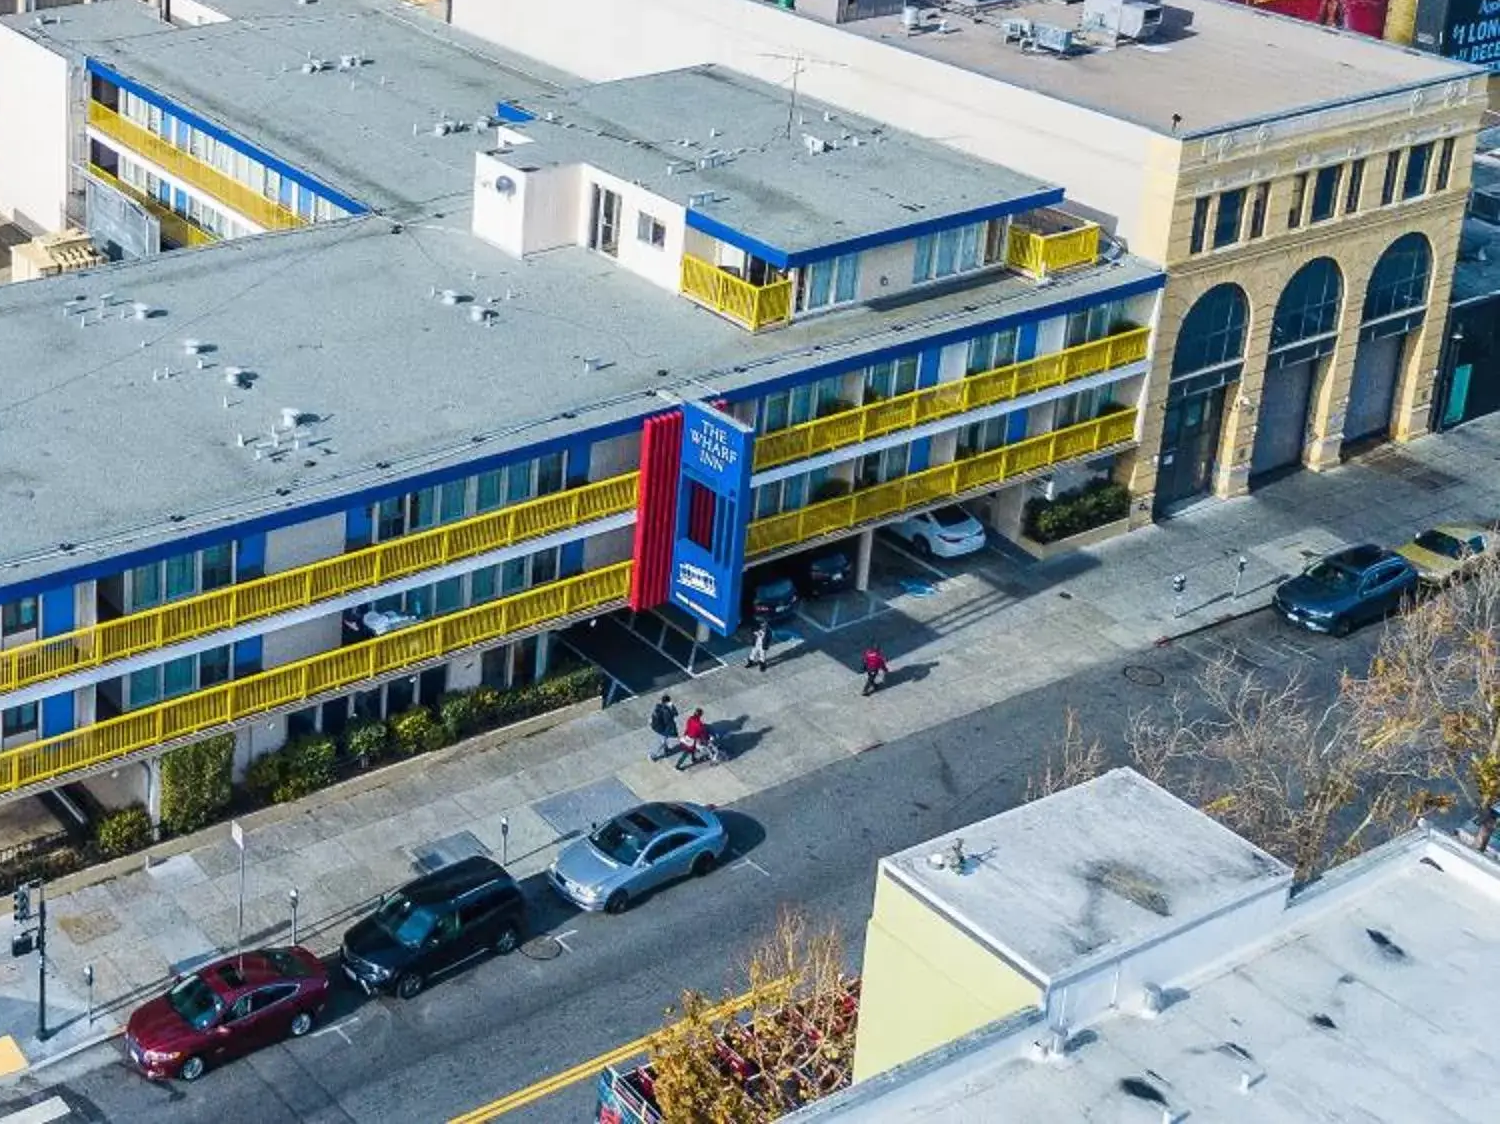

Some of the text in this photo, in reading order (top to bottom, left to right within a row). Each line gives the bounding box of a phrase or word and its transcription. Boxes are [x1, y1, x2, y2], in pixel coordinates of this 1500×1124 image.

[1468, 19, 1500, 43] LON
[702, 419, 728, 443] THE
[690, 428, 738, 464] WHARF
[699, 449, 724, 472] INN
